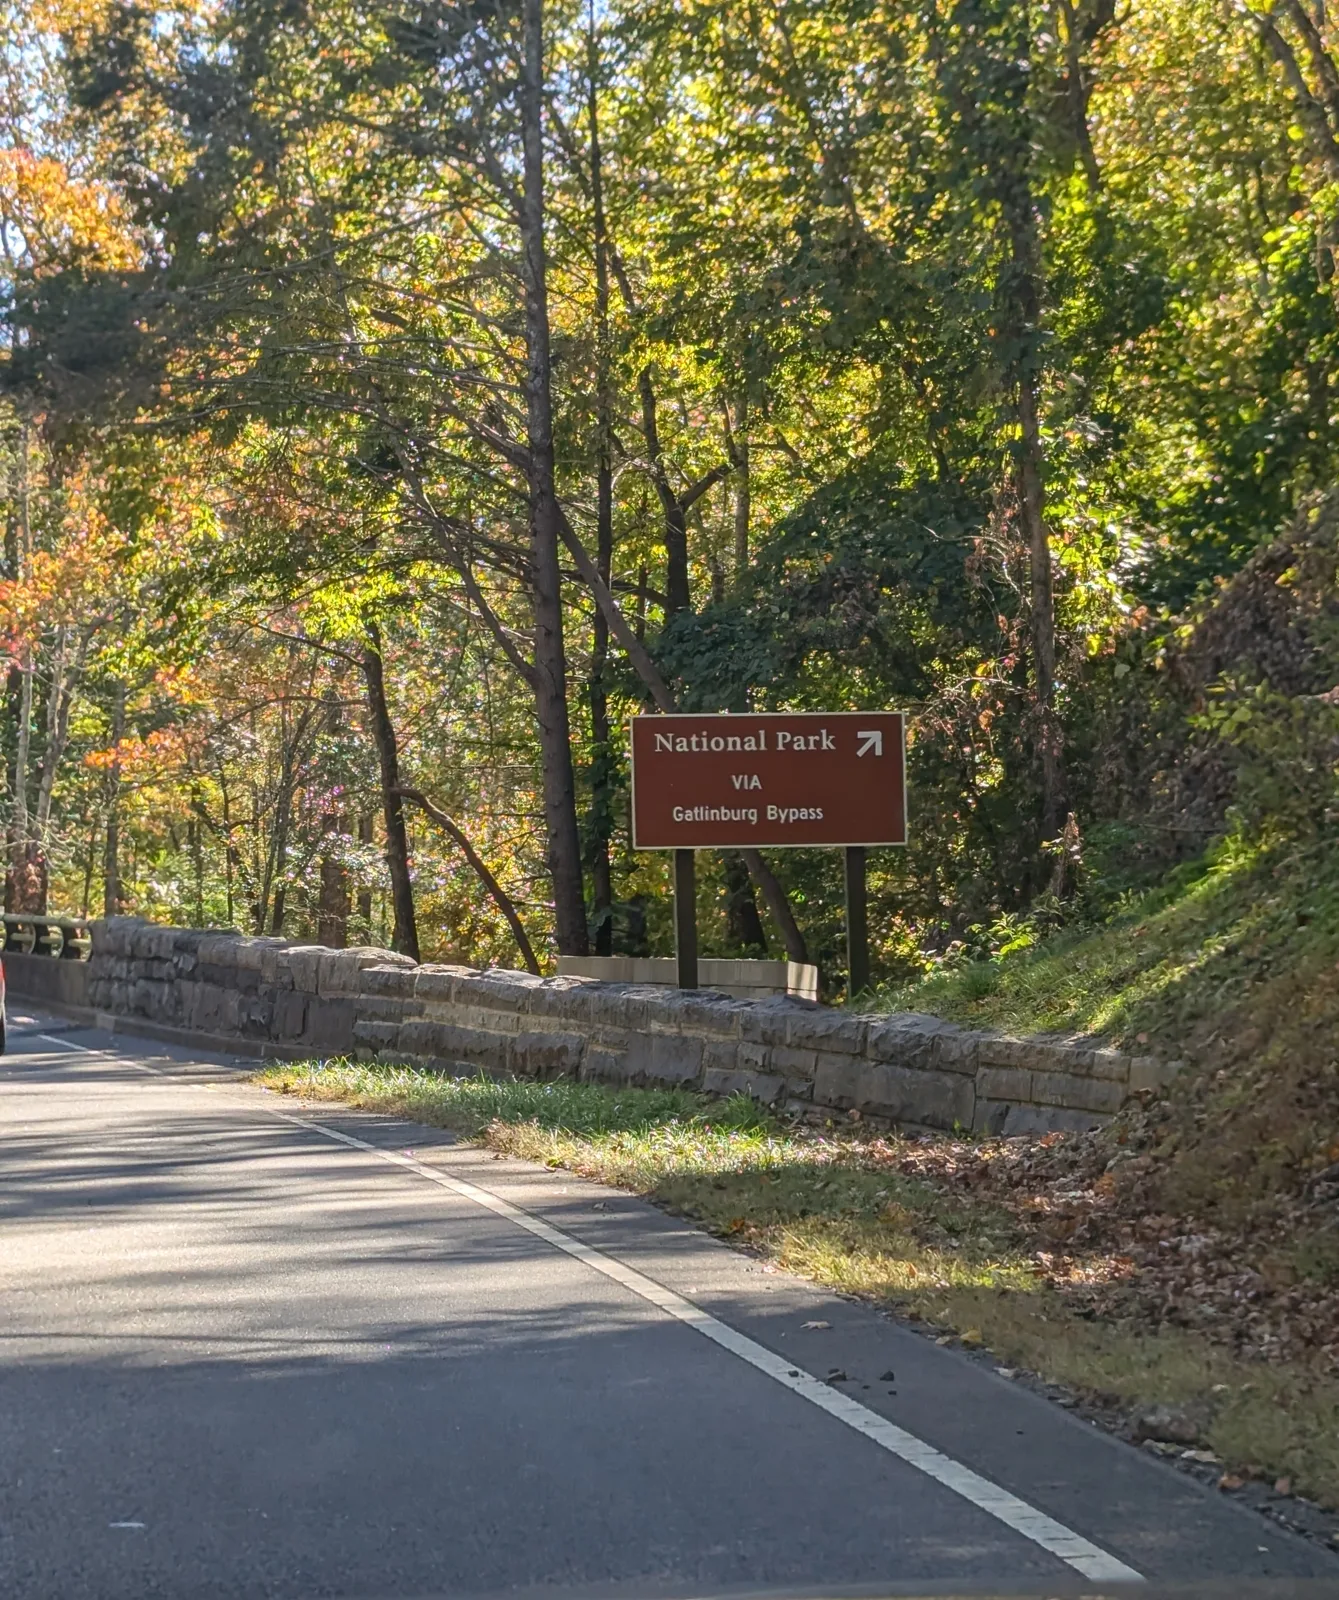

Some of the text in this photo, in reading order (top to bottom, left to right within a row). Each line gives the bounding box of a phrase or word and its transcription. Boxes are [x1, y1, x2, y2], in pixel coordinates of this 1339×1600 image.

[654, 729, 836, 752] National Park
[731, 774, 762, 790] VIA
[673, 805, 824, 825] Gatlinburg Bypass
